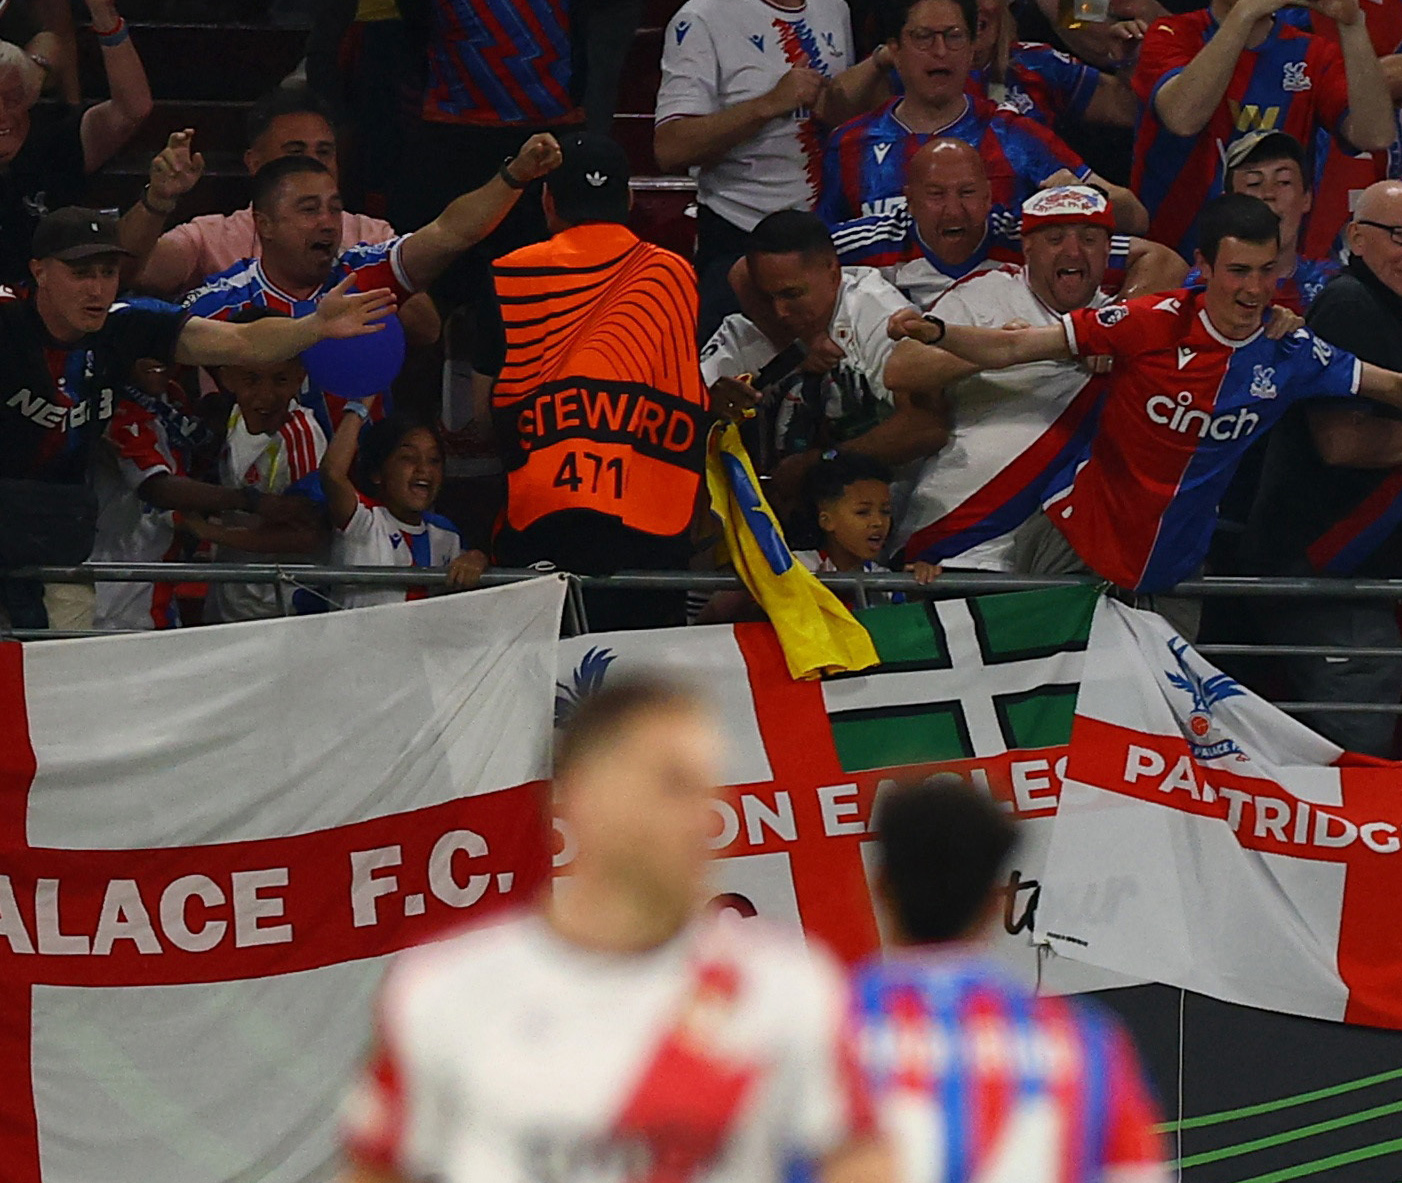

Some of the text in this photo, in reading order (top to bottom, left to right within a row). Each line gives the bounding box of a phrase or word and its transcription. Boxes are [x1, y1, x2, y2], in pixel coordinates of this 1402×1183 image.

[1145, 390, 1260, 442] cinch
[552, 451, 625, 500] 471
[349, 828, 515, 928] F.C.
